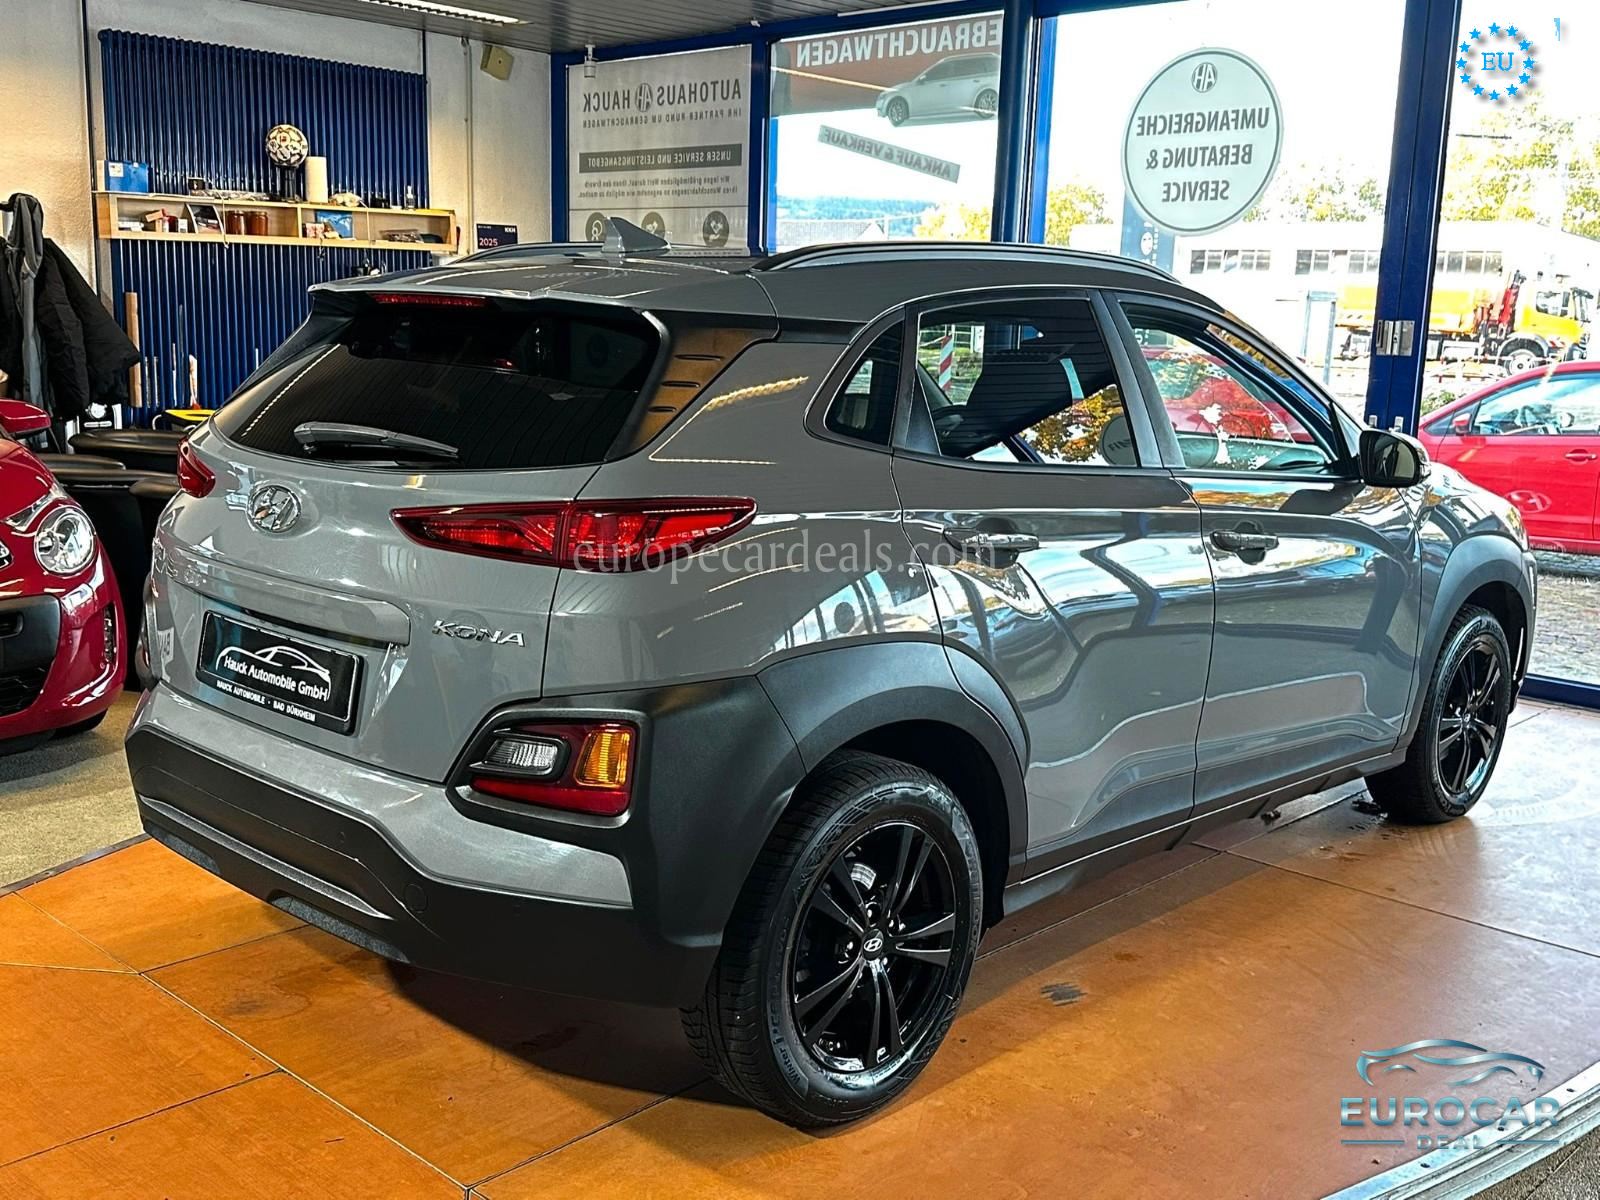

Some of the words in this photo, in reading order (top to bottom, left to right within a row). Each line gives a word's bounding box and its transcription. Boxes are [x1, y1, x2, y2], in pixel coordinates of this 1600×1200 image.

[479, 237, 498, 247] 2025
[432, 619, 525, 647] KONA
[223, 656, 247, 675] Hauck
[248, 666, 296, 692] Automobile
[298, 681, 329, 702] GmbH
[216, 680, 233, 693] HAUCK
[233, 686, 266, 705] AUTOMOBILE
[273, 700, 285, 711] BAD
[286, 704, 316, 722] DÜRKHEIM
